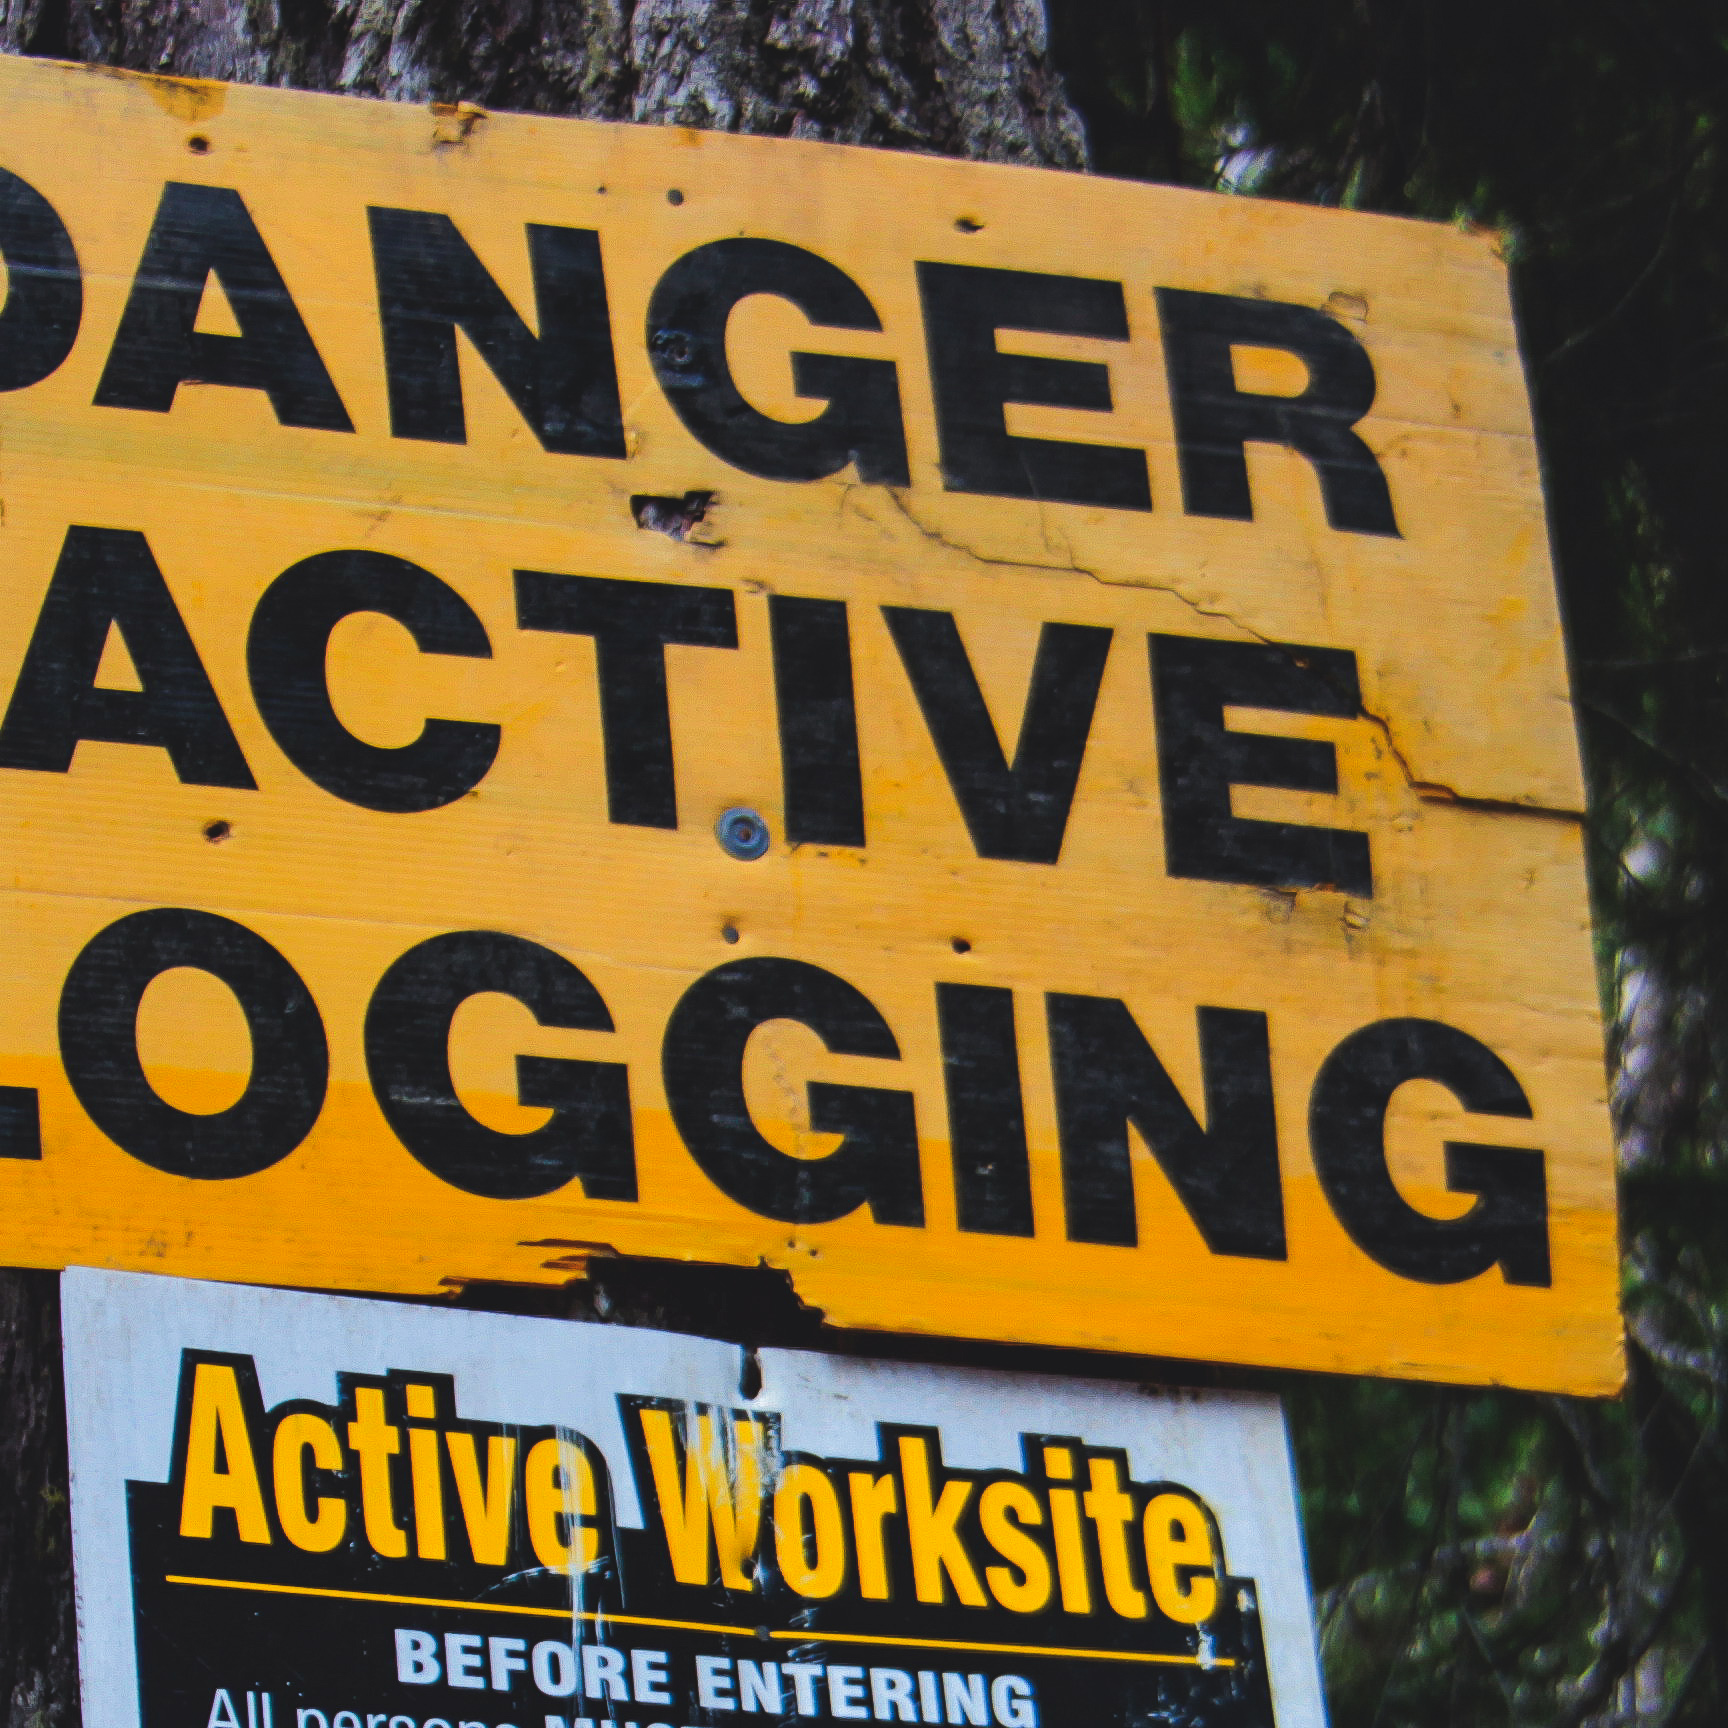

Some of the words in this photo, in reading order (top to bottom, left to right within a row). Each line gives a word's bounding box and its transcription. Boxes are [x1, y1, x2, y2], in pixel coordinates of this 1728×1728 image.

[179, 1363, 600, 1576] Active
[639, 1406, 1217, 1624] Worksite
[394, 1628, 672, 1704] BEFORE
